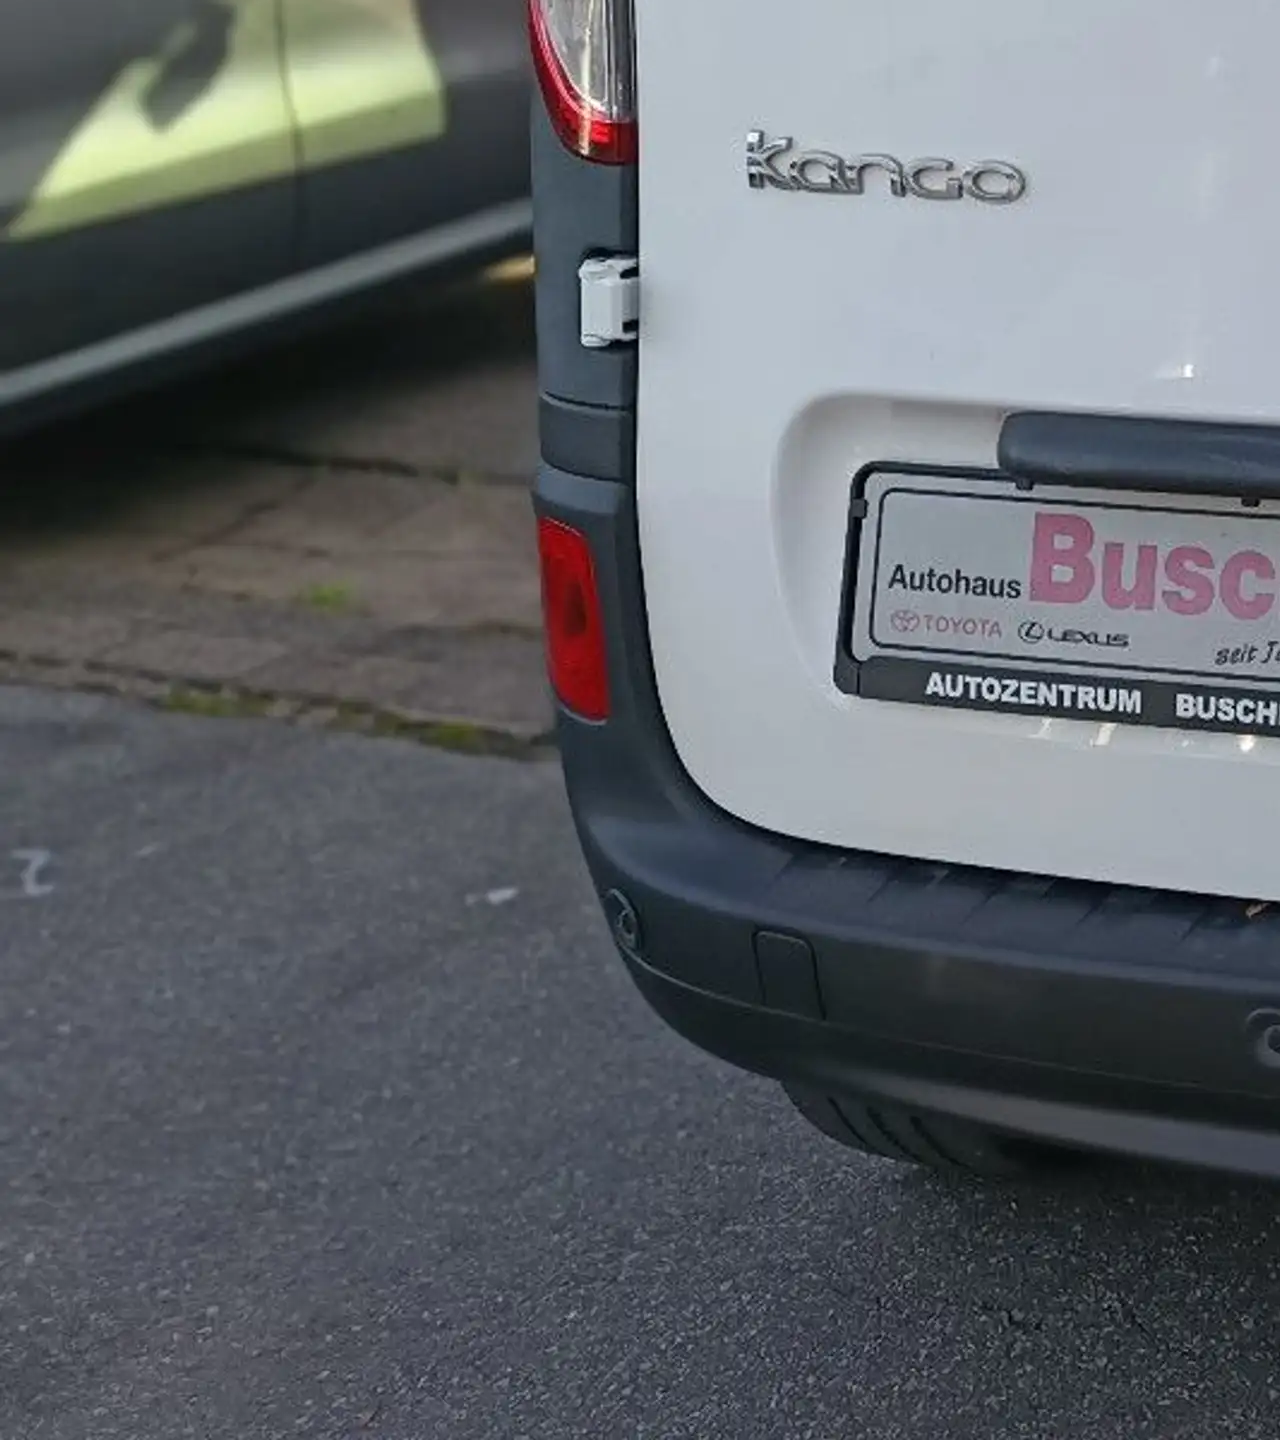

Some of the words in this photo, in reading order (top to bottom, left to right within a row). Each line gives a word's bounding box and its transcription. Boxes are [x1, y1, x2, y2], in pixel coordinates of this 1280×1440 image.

[888, 563, 1022, 599] Autohaus
[923, 614, 1003, 639] TOYOTA
[1046, 627, 1130, 647] LEXUS
[1214, 643, 1259, 666] seit
[924, 670, 1142, 715] AUTOZENTRUM
